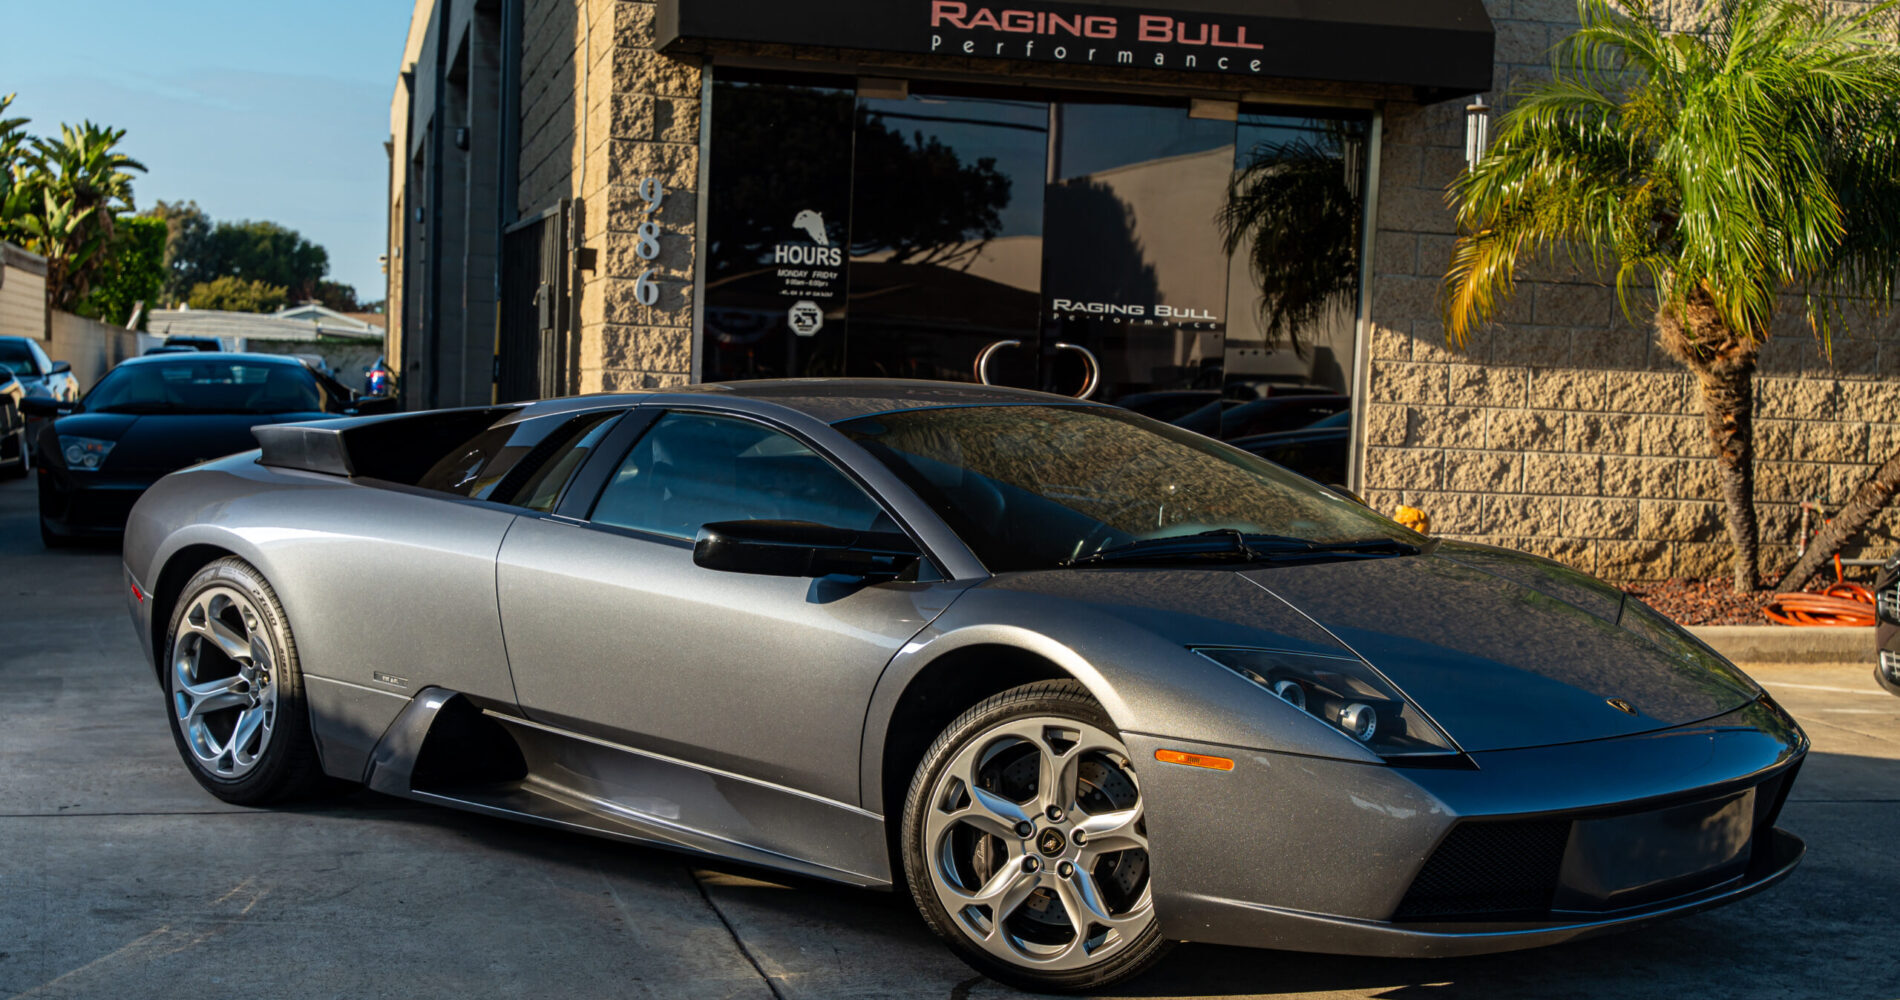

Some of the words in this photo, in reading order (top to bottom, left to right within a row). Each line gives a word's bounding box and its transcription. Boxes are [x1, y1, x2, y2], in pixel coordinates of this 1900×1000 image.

[931, 0, 1117, 39] RAGING
[1138, 14, 1264, 49] BULL
[931, 35, 1262, 72] Performance
[775, 244, 842, 266] HOURS
[777, 269, 808, 278] MONDAY
[812, 270, 838, 279] FRIDAY
[1052, 299, 1145, 316] RAGING
[1154, 304, 1217, 320] BULL
